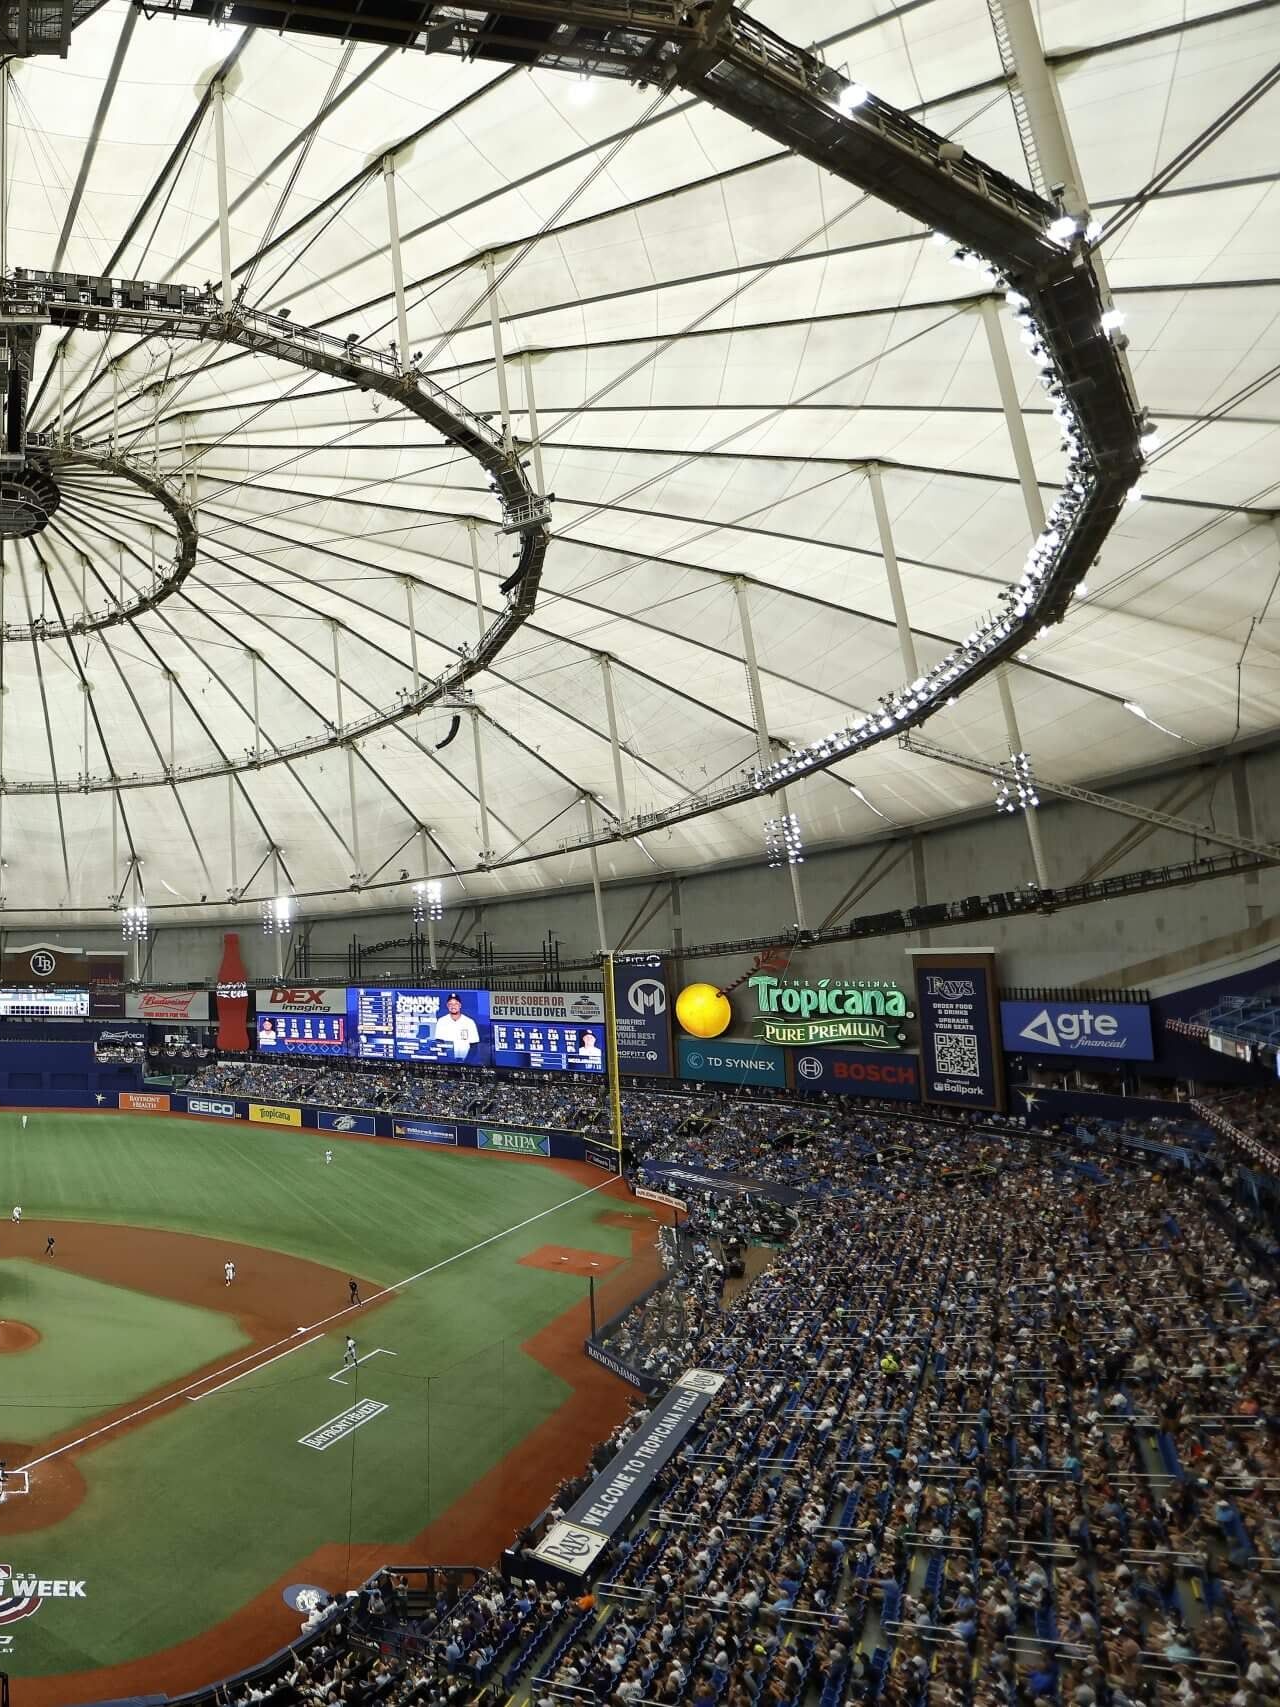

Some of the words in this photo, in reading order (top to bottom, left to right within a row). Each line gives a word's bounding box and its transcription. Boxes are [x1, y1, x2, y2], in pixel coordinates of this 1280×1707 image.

[270, 987, 326, 1004] DEX
[926, 976, 976, 1000] RAYS
[495, 995, 520, 1005] DRIVE
[521, 996, 550, 1006] SOBER
[552, 997, 564, 1006] OR
[748, 976, 906, 1018] Tropicana
[282, 1004, 331, 1012] imaging
[493, 1006, 508, 1015] GET
[510, 1007, 542, 1016] PULLED
[544, 1008, 567, 1017] OVER
[765, 1024, 805, 1041] PURE
[808, 1023, 885, 1040] PREMIUM
[1057, 1010, 1118, 1040] gte
[1071, 1036, 1128, 1049] financial
[707, 1057, 722, 1066] TD
[725, 1058, 775, 1071] SYNNEX
[832, 1062, 914, 1085] BOSCH
[944, 1083, 984, 1096] Ballpark
[132, 1101, 157, 1109] HEALTH
[189, 1102, 233, 1115] GEICO
[259, 1108, 291, 1121] Tropicana
[503, 1134, 537, 1150] RIPA
[589, 1346, 618, 1371] RAYMOND
[618, 1365, 640, 1387] JAMES
[305, 1419, 353, 1446] BAYFRONT
[345, 1402, 380, 1423] HEALTH
[581, 1472, 636, 1527] WELCOME
[624, 1459, 646, 1478] TO
[635, 1411, 680, 1460] TROPICANA
[675, 1391, 700, 1414] FIELD
[542, 1530, 591, 1563] RAYS
[12, 1580, 87, 1597] WEEK
